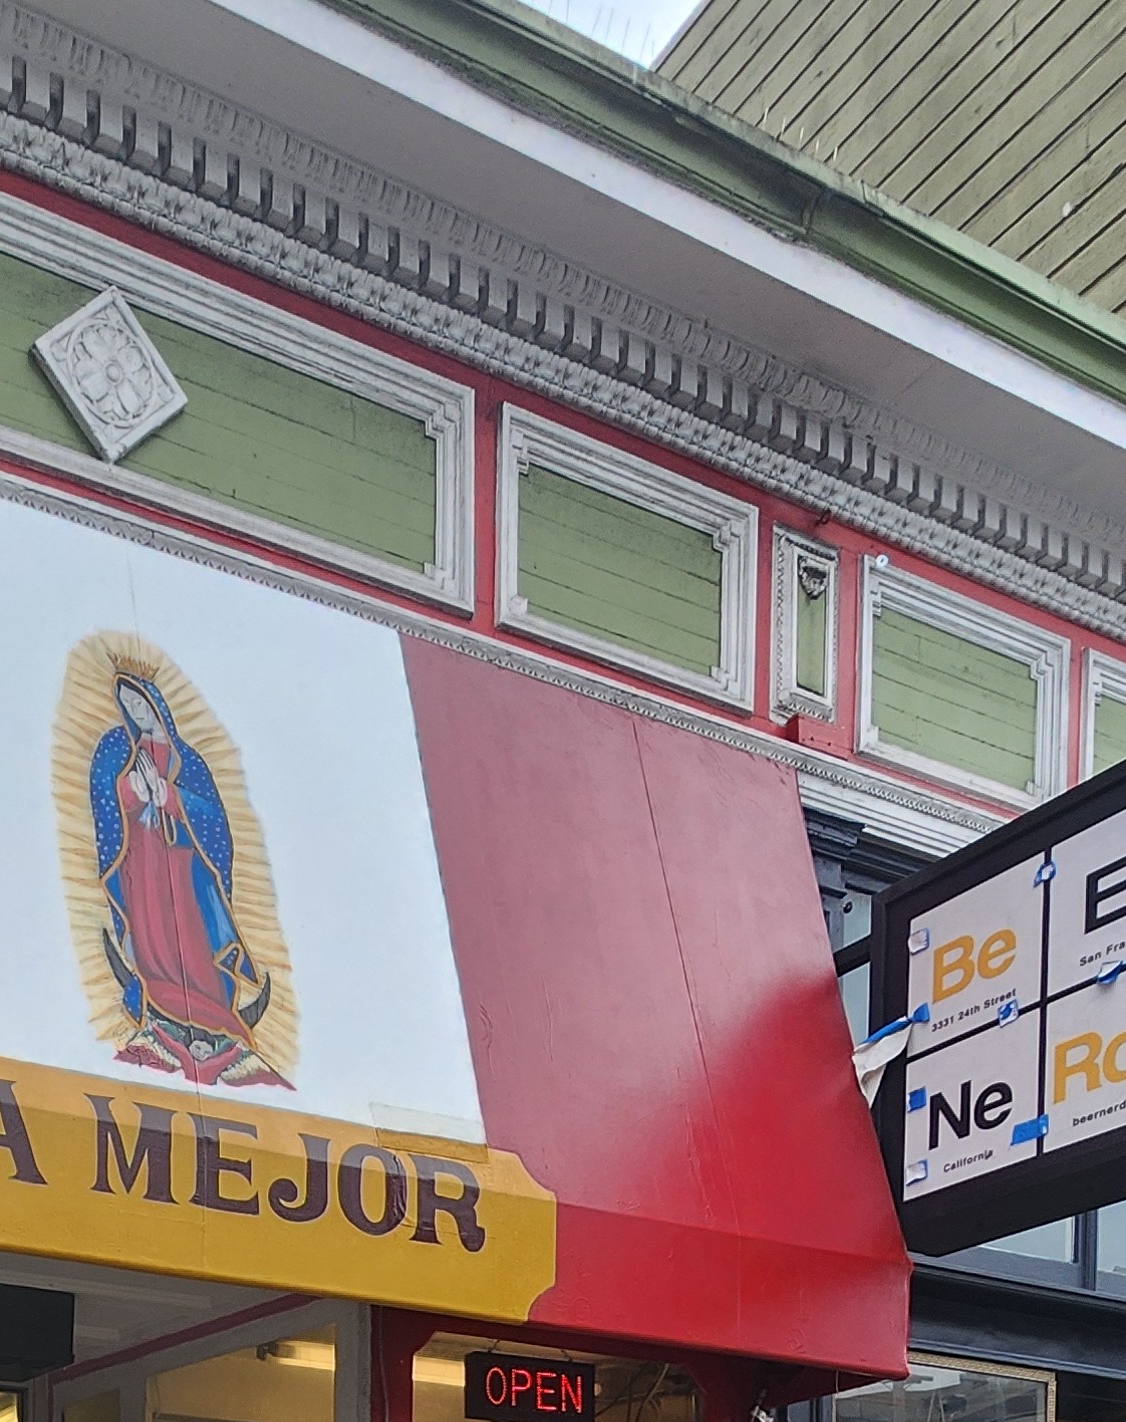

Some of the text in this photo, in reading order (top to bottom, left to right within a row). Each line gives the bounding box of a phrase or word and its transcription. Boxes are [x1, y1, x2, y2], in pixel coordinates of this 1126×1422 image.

[932, 929, 1016, 1005] Be
[1079, 951, 1102, 967] San
[931, 988, 1016, 1032] 3331 24th Street
[928, 1080, 1013, 1151] Ne
[84, 1092, 487, 1254] MEJOR
[943, 1150, 994, 1173] California
[485, 1366, 582, 1414] OPEN
